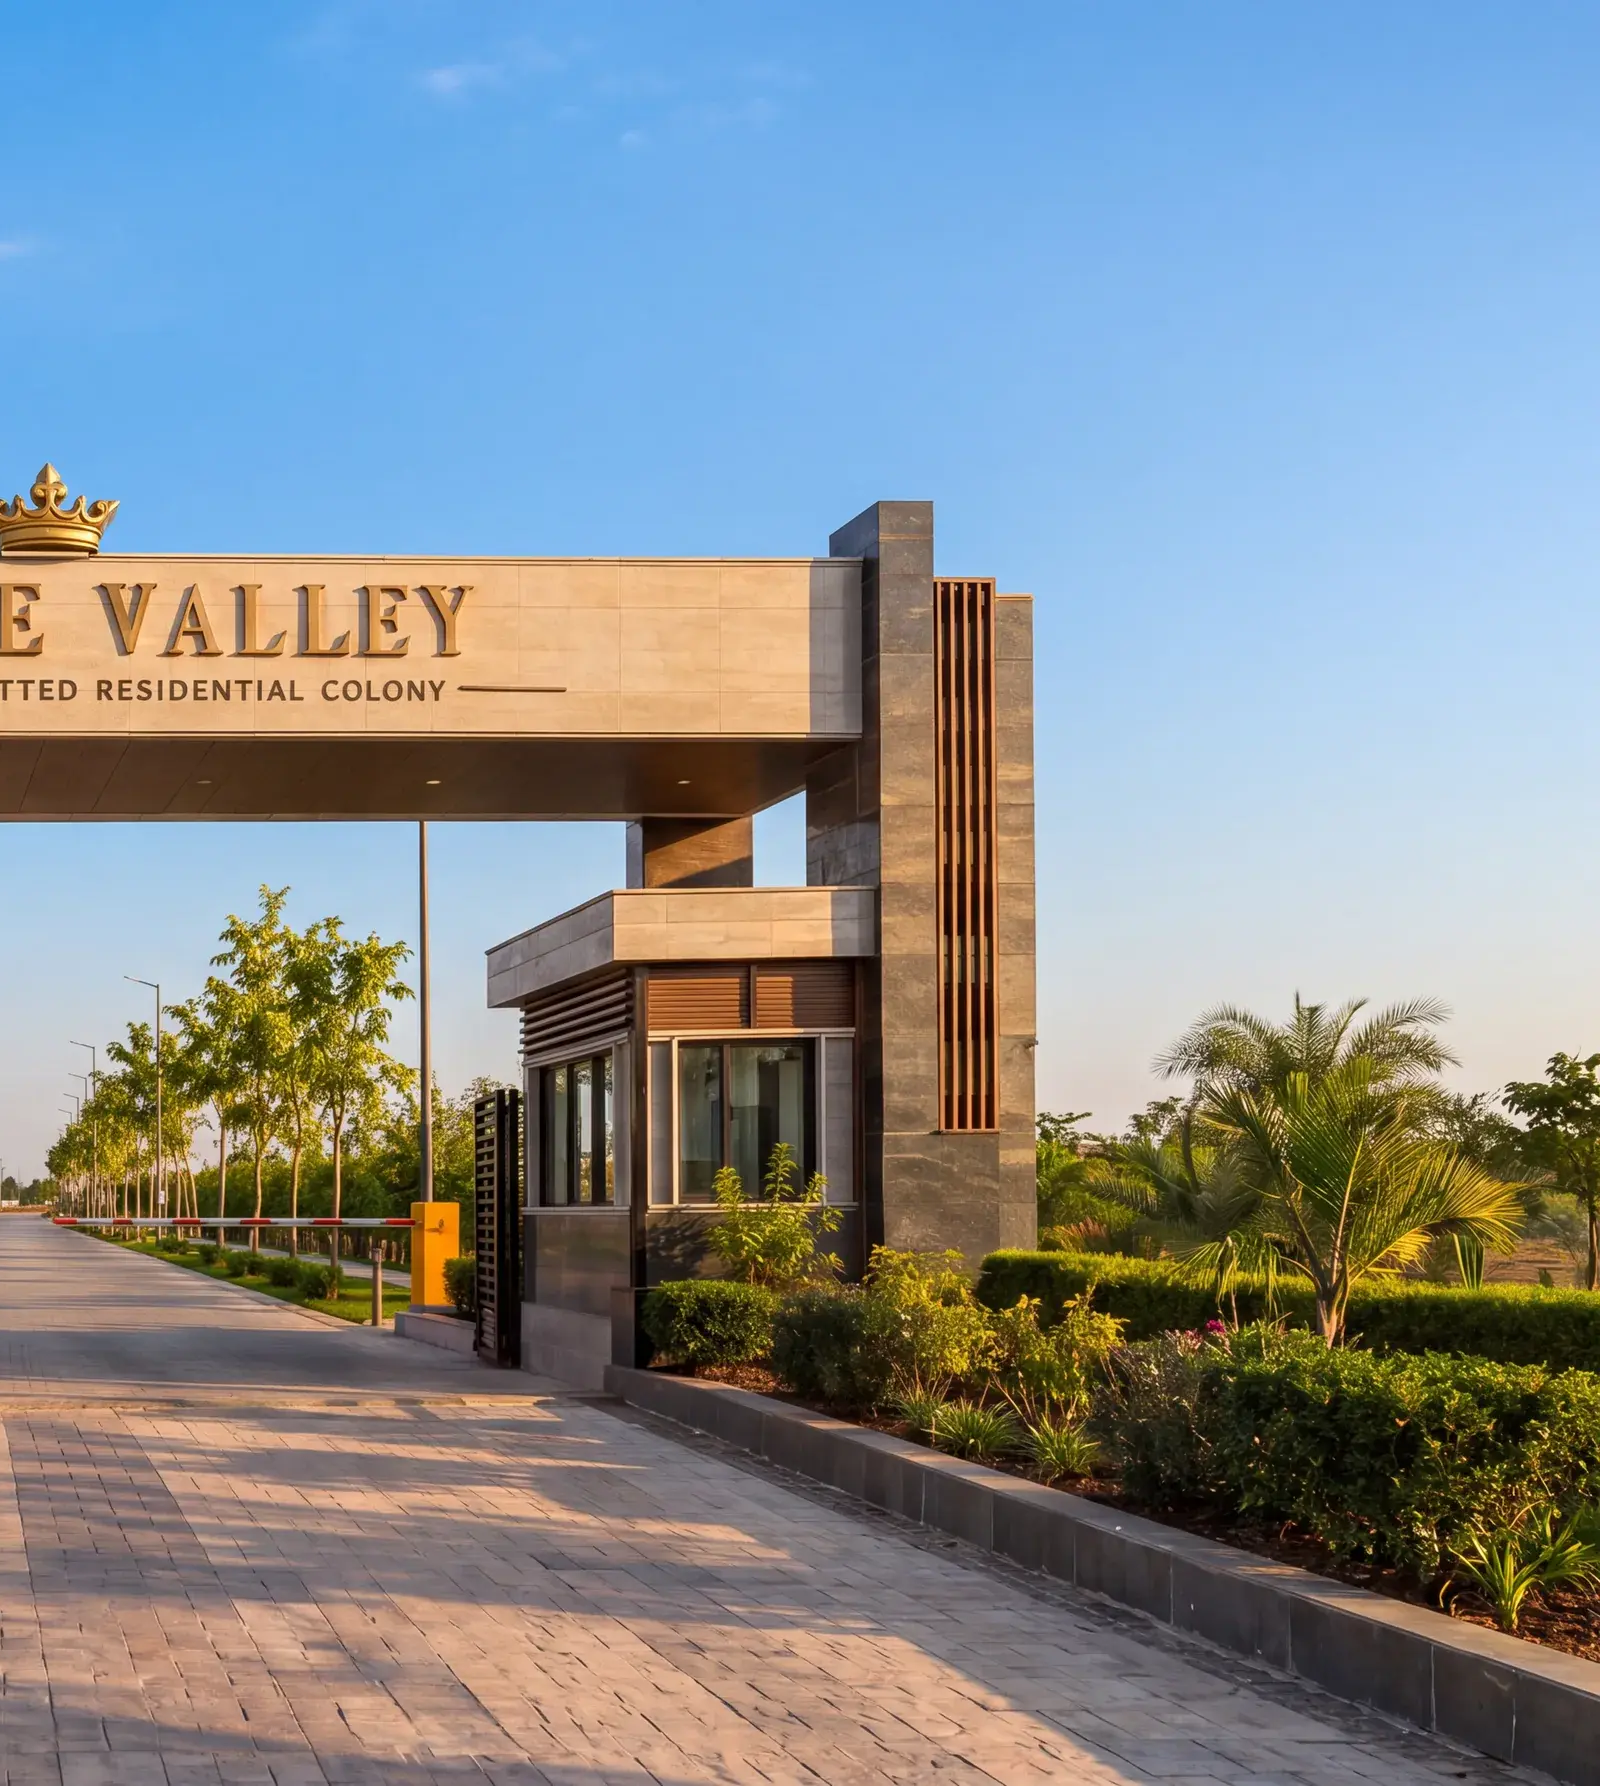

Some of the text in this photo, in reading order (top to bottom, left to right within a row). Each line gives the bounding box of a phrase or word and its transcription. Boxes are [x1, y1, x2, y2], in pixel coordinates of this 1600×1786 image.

[97, 582, 475, 657] VALLEY
[96, 679, 305, 702] RESIDENTIAL
[322, 679, 446, 702] COLONY
